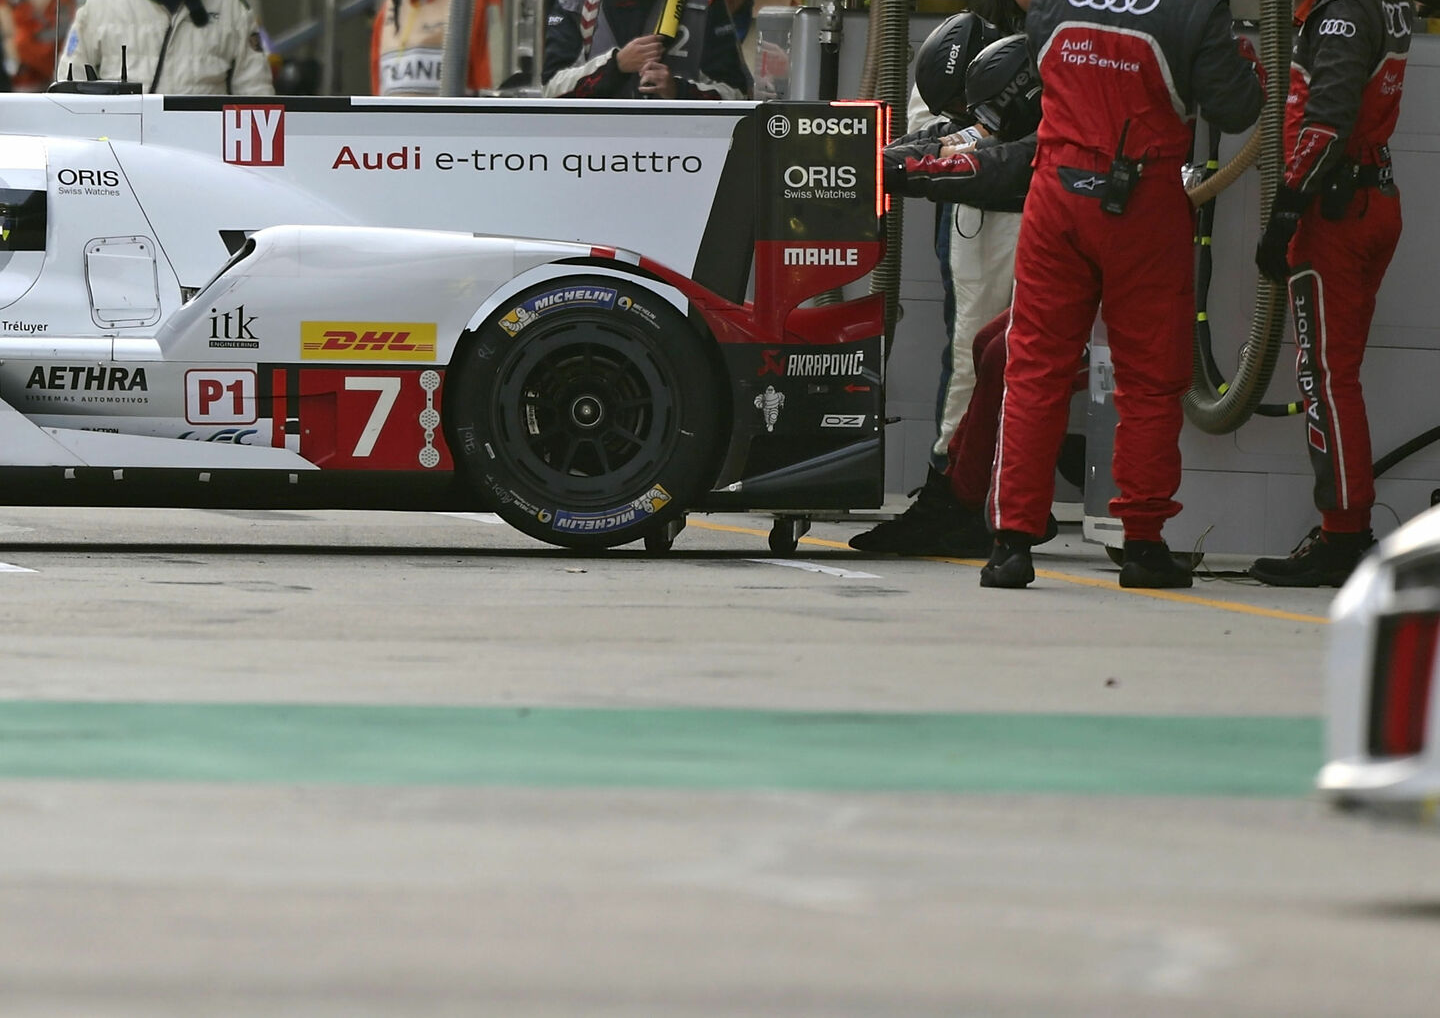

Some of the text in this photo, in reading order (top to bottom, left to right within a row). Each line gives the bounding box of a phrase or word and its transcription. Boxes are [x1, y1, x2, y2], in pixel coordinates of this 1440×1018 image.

[1062, 39, 1092, 51] Audi
[945, 44, 961, 74] uvex
[1061, 51, 1140, 71] Top Service
[224, 108, 283, 163] HY
[798, 118, 867, 135] BOSCH
[332, 145, 703, 179] Audi e-tron quattro
[57, 169, 120, 187] ORIS
[784, 166, 856, 188] ORIS
[58, 186, 120, 197] Swiss Watches
[784, 190, 856, 199] Swiss Watches
[784, 248, 858, 266] MAHLE
[534, 290, 613, 311] MICHELIN
[2, 318, 49, 333] Tréluyer
[209, 304, 260, 339] itk
[321, 331, 418, 351] DHL
[26, 365, 148, 392] AETHRA
[25, 394, 149, 404] SISTEMAS AUTOMOTIVOS
[198, 379, 244, 416] P1
[344, 377, 402, 457] 7
[557, 510, 636, 531] MICHELIN
